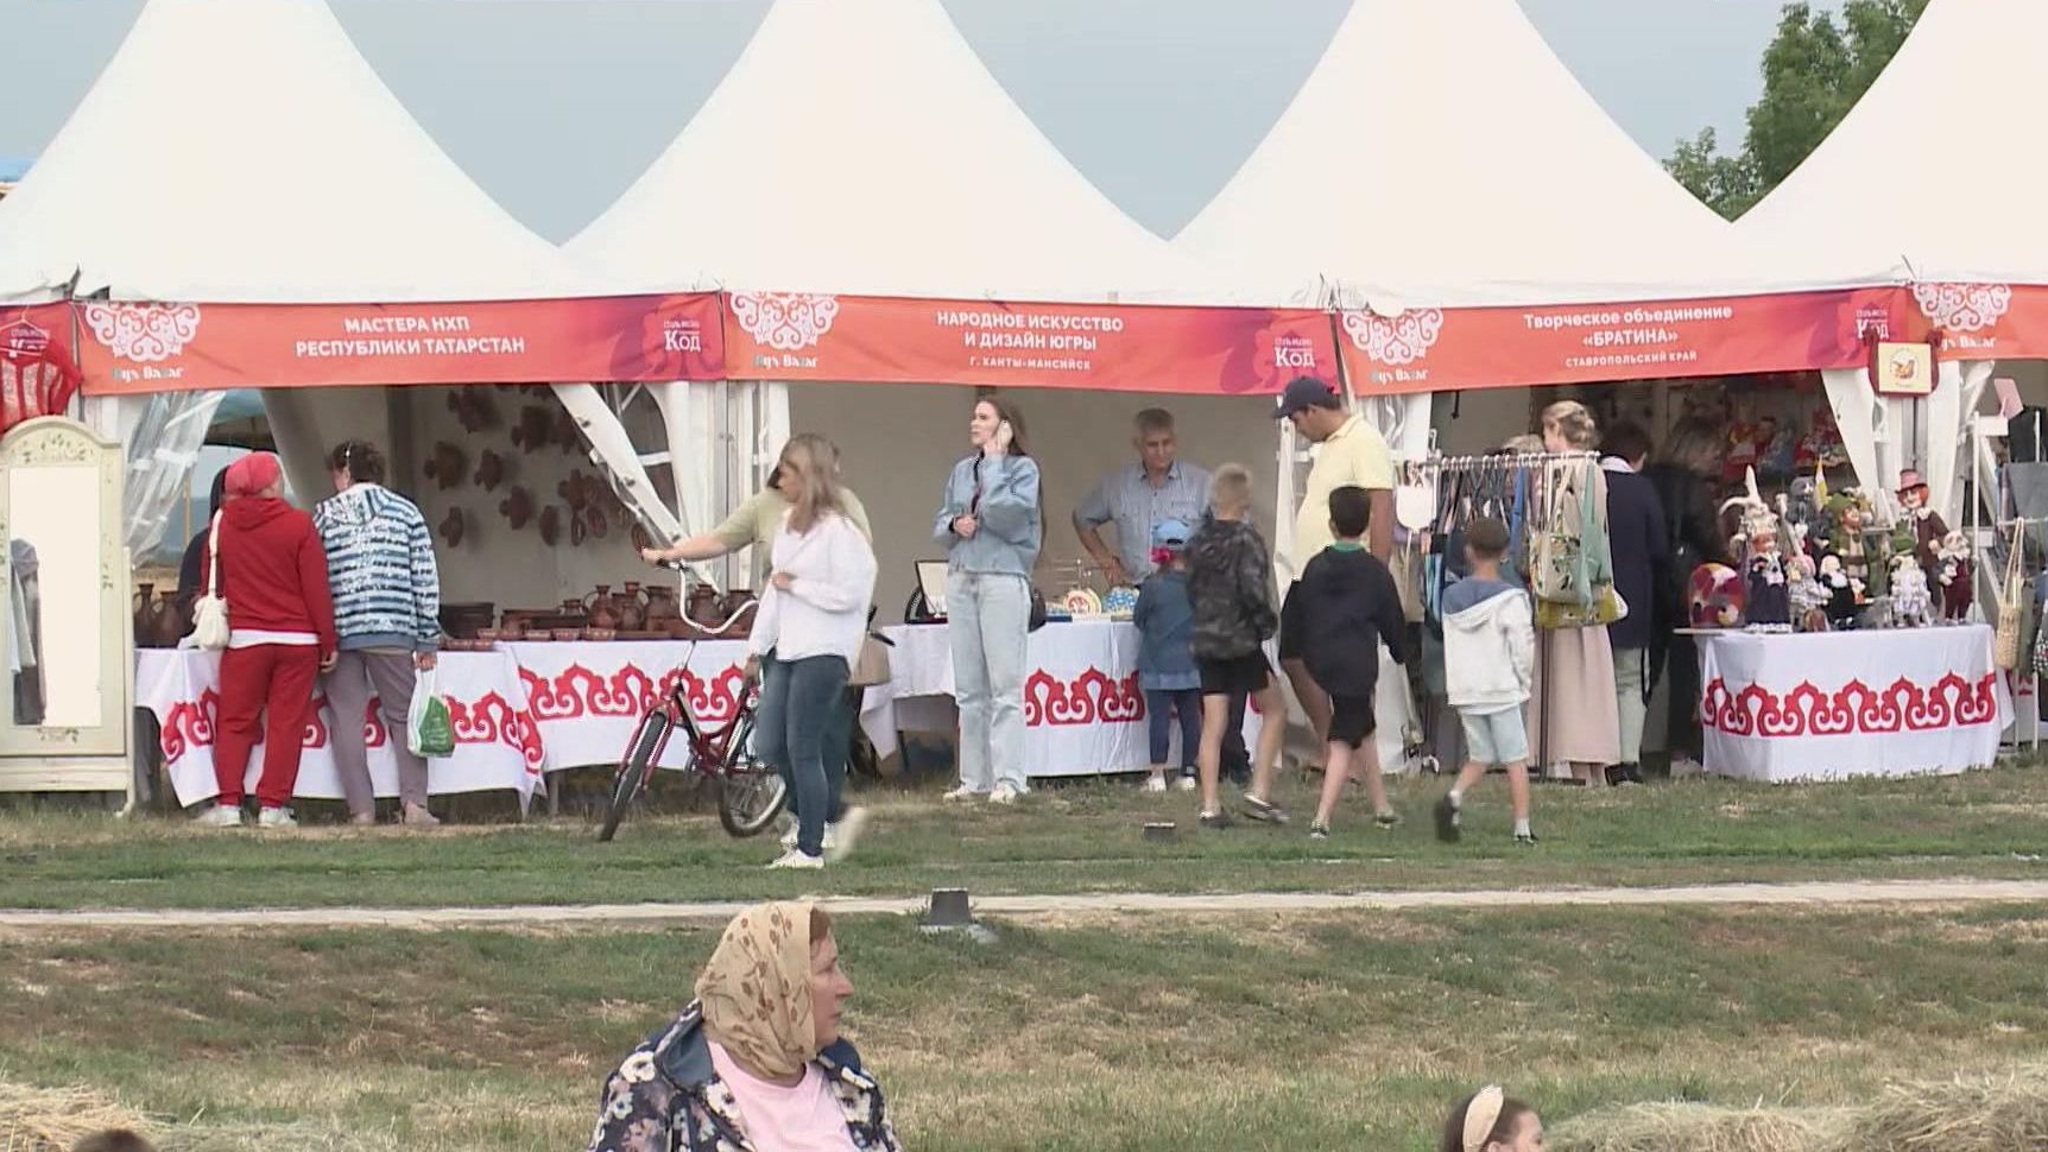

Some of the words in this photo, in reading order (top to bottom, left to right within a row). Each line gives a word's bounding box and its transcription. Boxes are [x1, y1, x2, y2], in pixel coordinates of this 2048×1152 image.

[344, 317, 428, 334] МАСТЕРА
[432, 316, 470, 331] НХП
[937, 311, 1026, 329] НАРОДНОЕ
[1029, 315, 1123, 332] ИСКУССТВО
[1524, 312, 1620, 330] Творческое
[1624, 305, 1733, 324] объединение
[296, 339, 421, 357] РЕСПУБЛИКИ
[424, 337, 525, 355] ТАТАРСТАН
[664, 330, 701, 352] Код
[965, 332, 976, 346] И
[980, 331, 1046, 350] ДИЗАЙН
[1050, 335, 1096, 350] ЮГРЫ
[1583, 328, 1678, 347] «БРАТИНА»
[983, 356, 1091, 371] ХАНТЫ-МАНСИЙСК
[1274, 347, 1316, 368] Код
[1566, 351, 1666, 367] СТАВРОПОЛЬСКИЙ
[1669, 350, 1698, 362] КРАЙ
